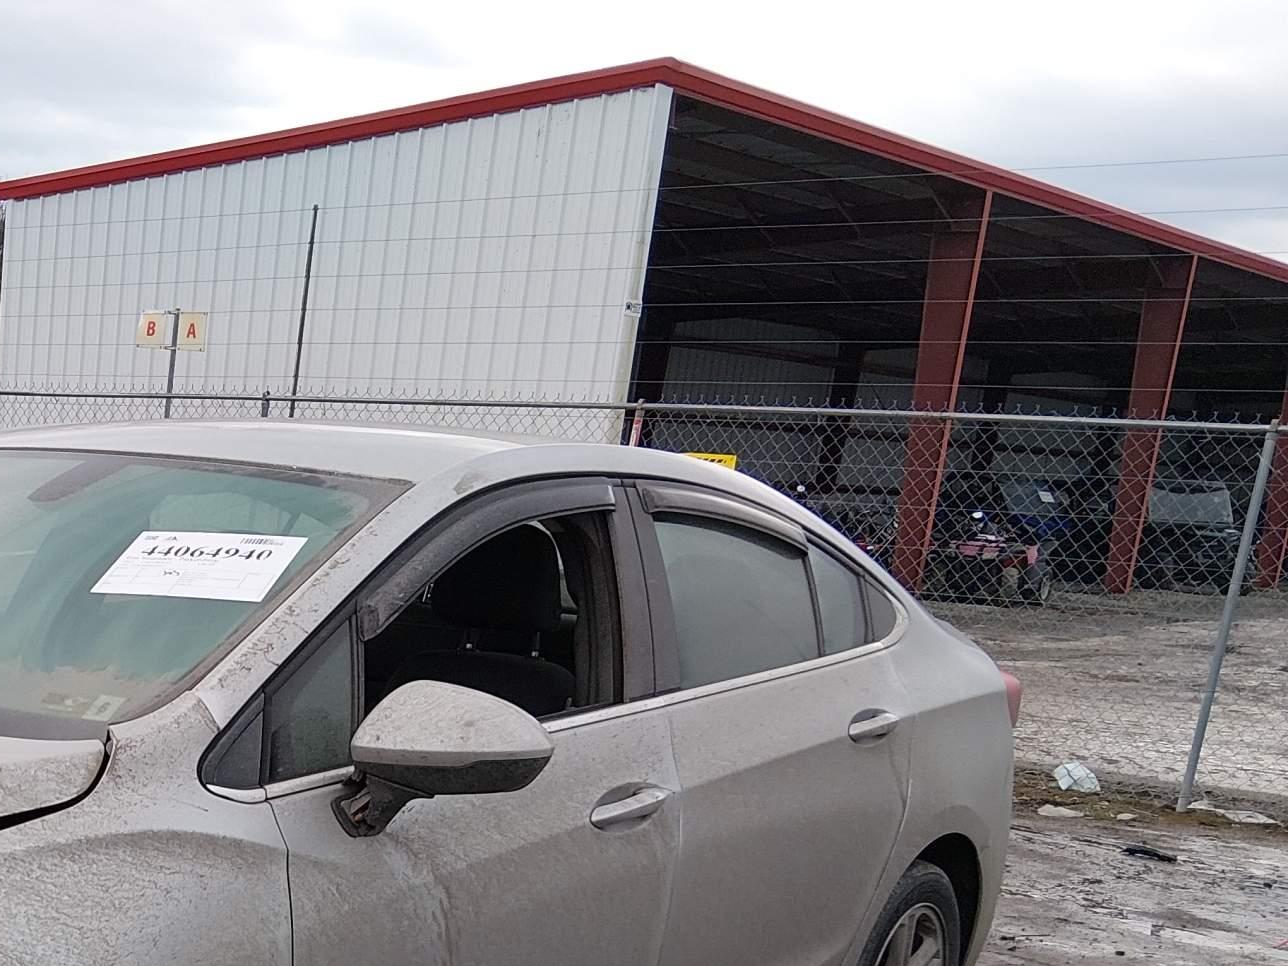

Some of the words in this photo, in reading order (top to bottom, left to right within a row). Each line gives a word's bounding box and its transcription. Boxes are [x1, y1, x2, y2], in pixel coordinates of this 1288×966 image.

[146, 321, 156, 336] B
[186, 323, 196, 338] A
[141, 545, 273, 560] 44064940
